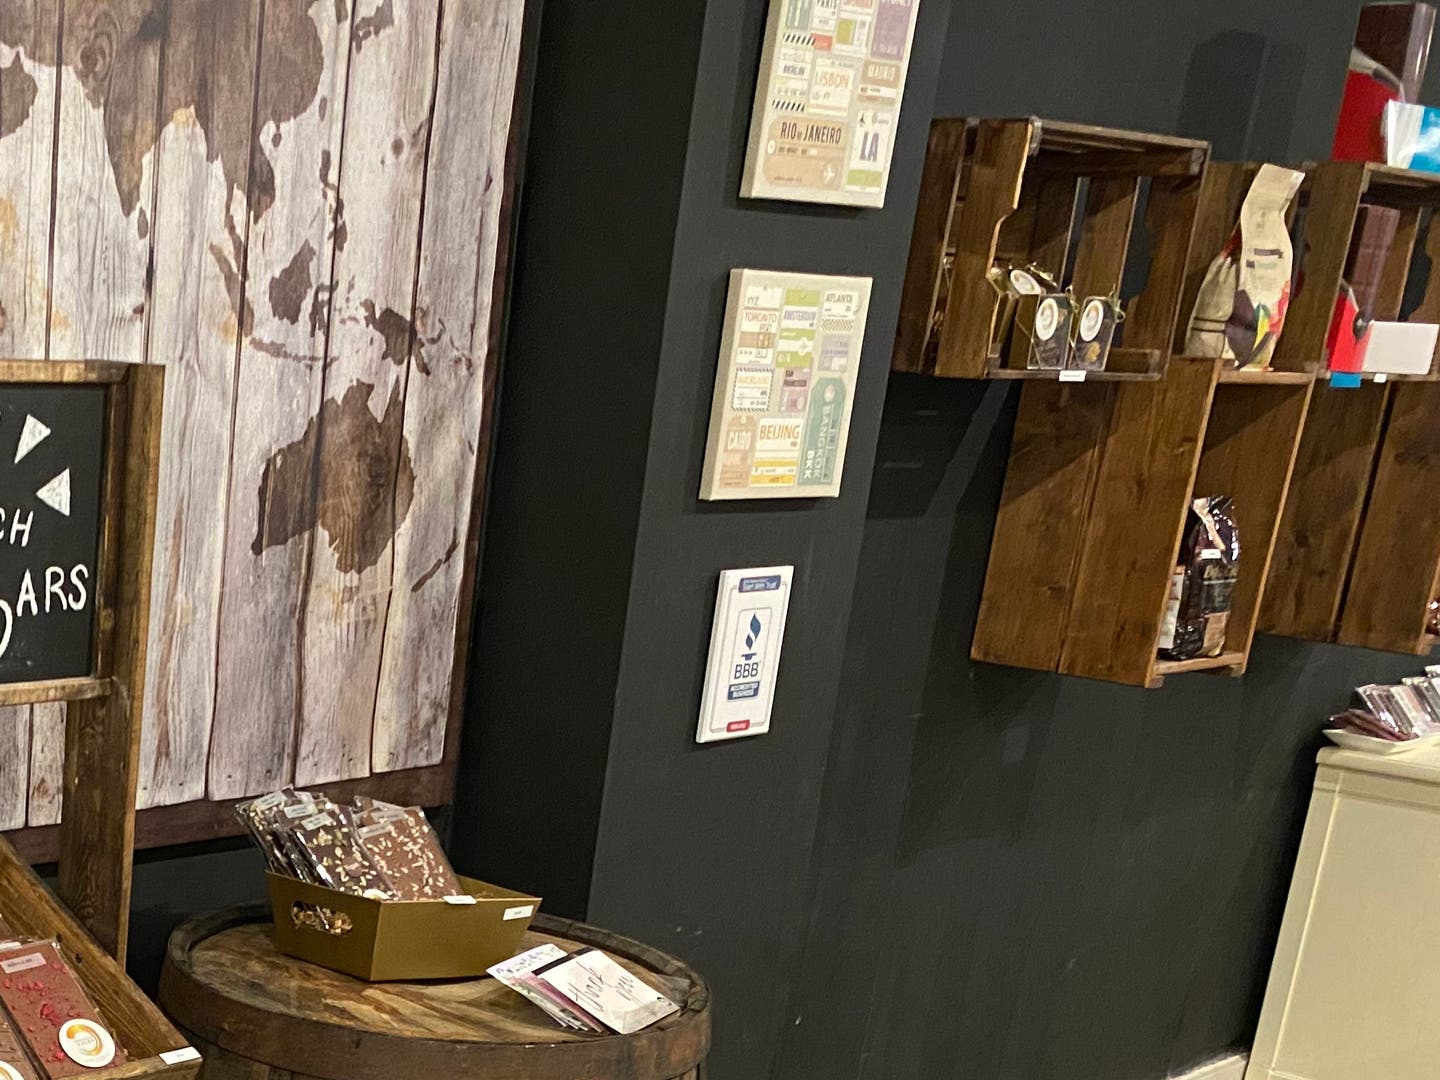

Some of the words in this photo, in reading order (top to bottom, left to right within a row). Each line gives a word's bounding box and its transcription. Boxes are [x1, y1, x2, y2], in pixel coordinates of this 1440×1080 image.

[815, 70, 850, 89] LISBON
[780, 121, 798, 140] RIO
[802, 124, 842, 145] JANEIRO
[859, 131, 880, 163] LA
[744, 310, 777, 323] TORONTO
[727, 430, 753, 452] CAIRO
[758, 423, 801, 441] BEIJING
[812, 405, 831, 479] BANGKOK
[803, 449, 816, 479] BKK
[734, 662, 759, 680] BBB
